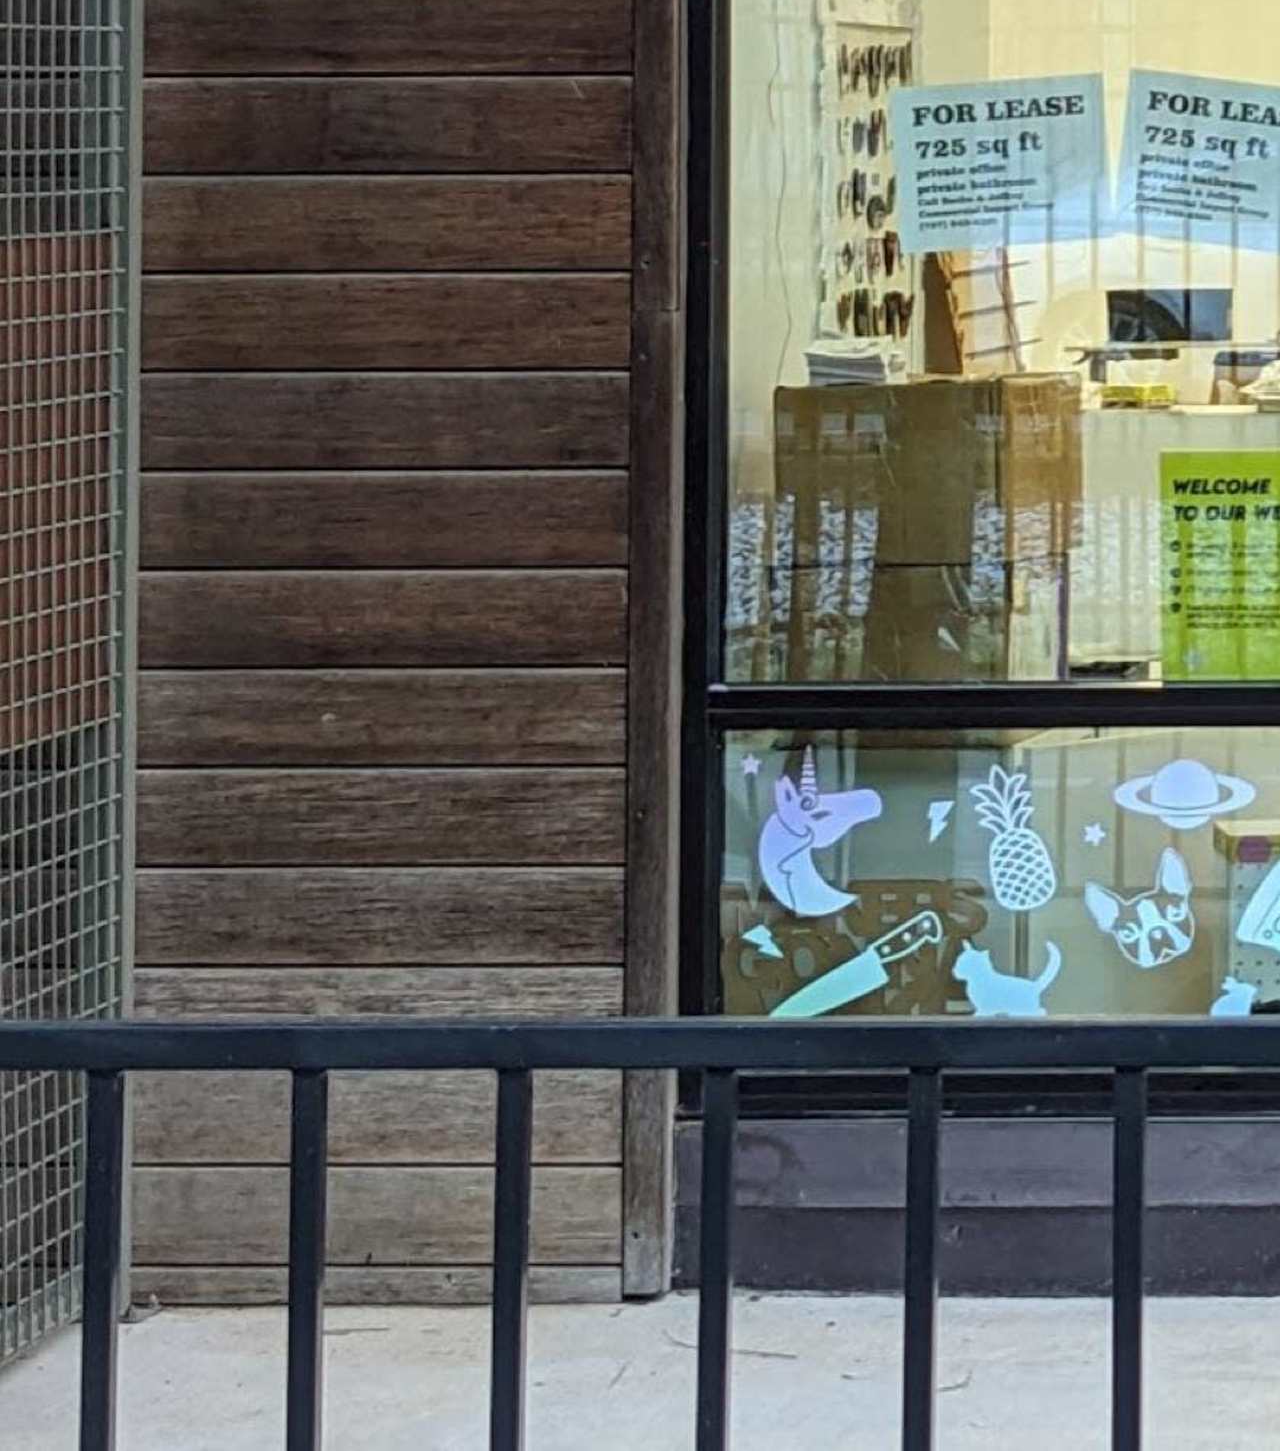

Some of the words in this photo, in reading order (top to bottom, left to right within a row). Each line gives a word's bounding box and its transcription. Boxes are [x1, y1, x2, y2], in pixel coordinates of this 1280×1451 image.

[912, 103, 976, 126] FOR
[987, 95, 1084, 121] LEASE
[1148, 90, 1211, 117] FOR
[916, 139, 967, 159] 725
[977, 138, 1009, 158] sq
[1019, 132, 1042, 151] ft
[1145, 126, 1195, 148] 725
[1204, 136, 1238, 159] sq
[1246, 137, 1270, 159] ft
[1172, 478, 1272, 495] WELCOME
[1173, 504, 1199, 522] TO
[1205, 504, 1246, 521] OUR
